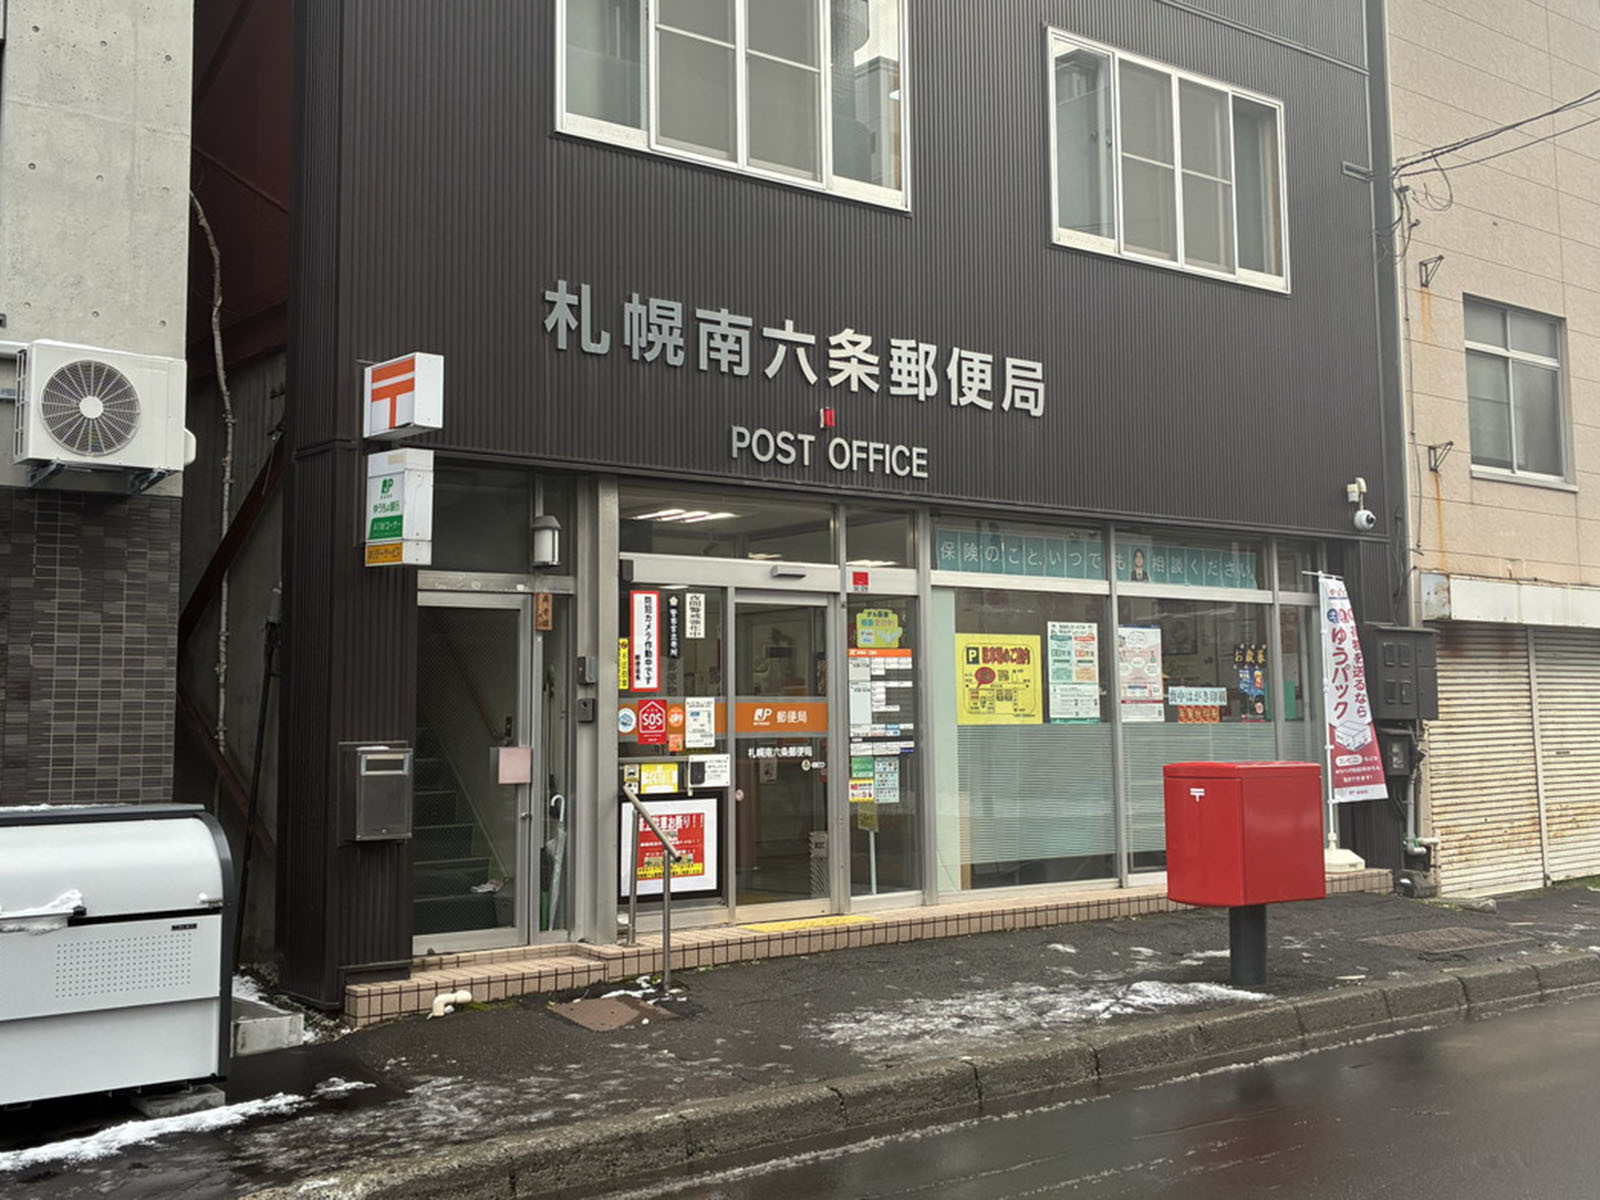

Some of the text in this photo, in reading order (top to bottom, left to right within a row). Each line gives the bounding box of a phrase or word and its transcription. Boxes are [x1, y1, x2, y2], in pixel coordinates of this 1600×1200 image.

[544, 279, 1046, 418] 札幌南六条郵便局
[731, 426, 929, 478] POST OFFICE
[1331, 627, 1350, 720] ゆうパック
[642, 713, 663, 725] SOS
[776, 710, 808, 724] 郵便局
[747, 746, 813, 758] 札幌南六条郵便局
